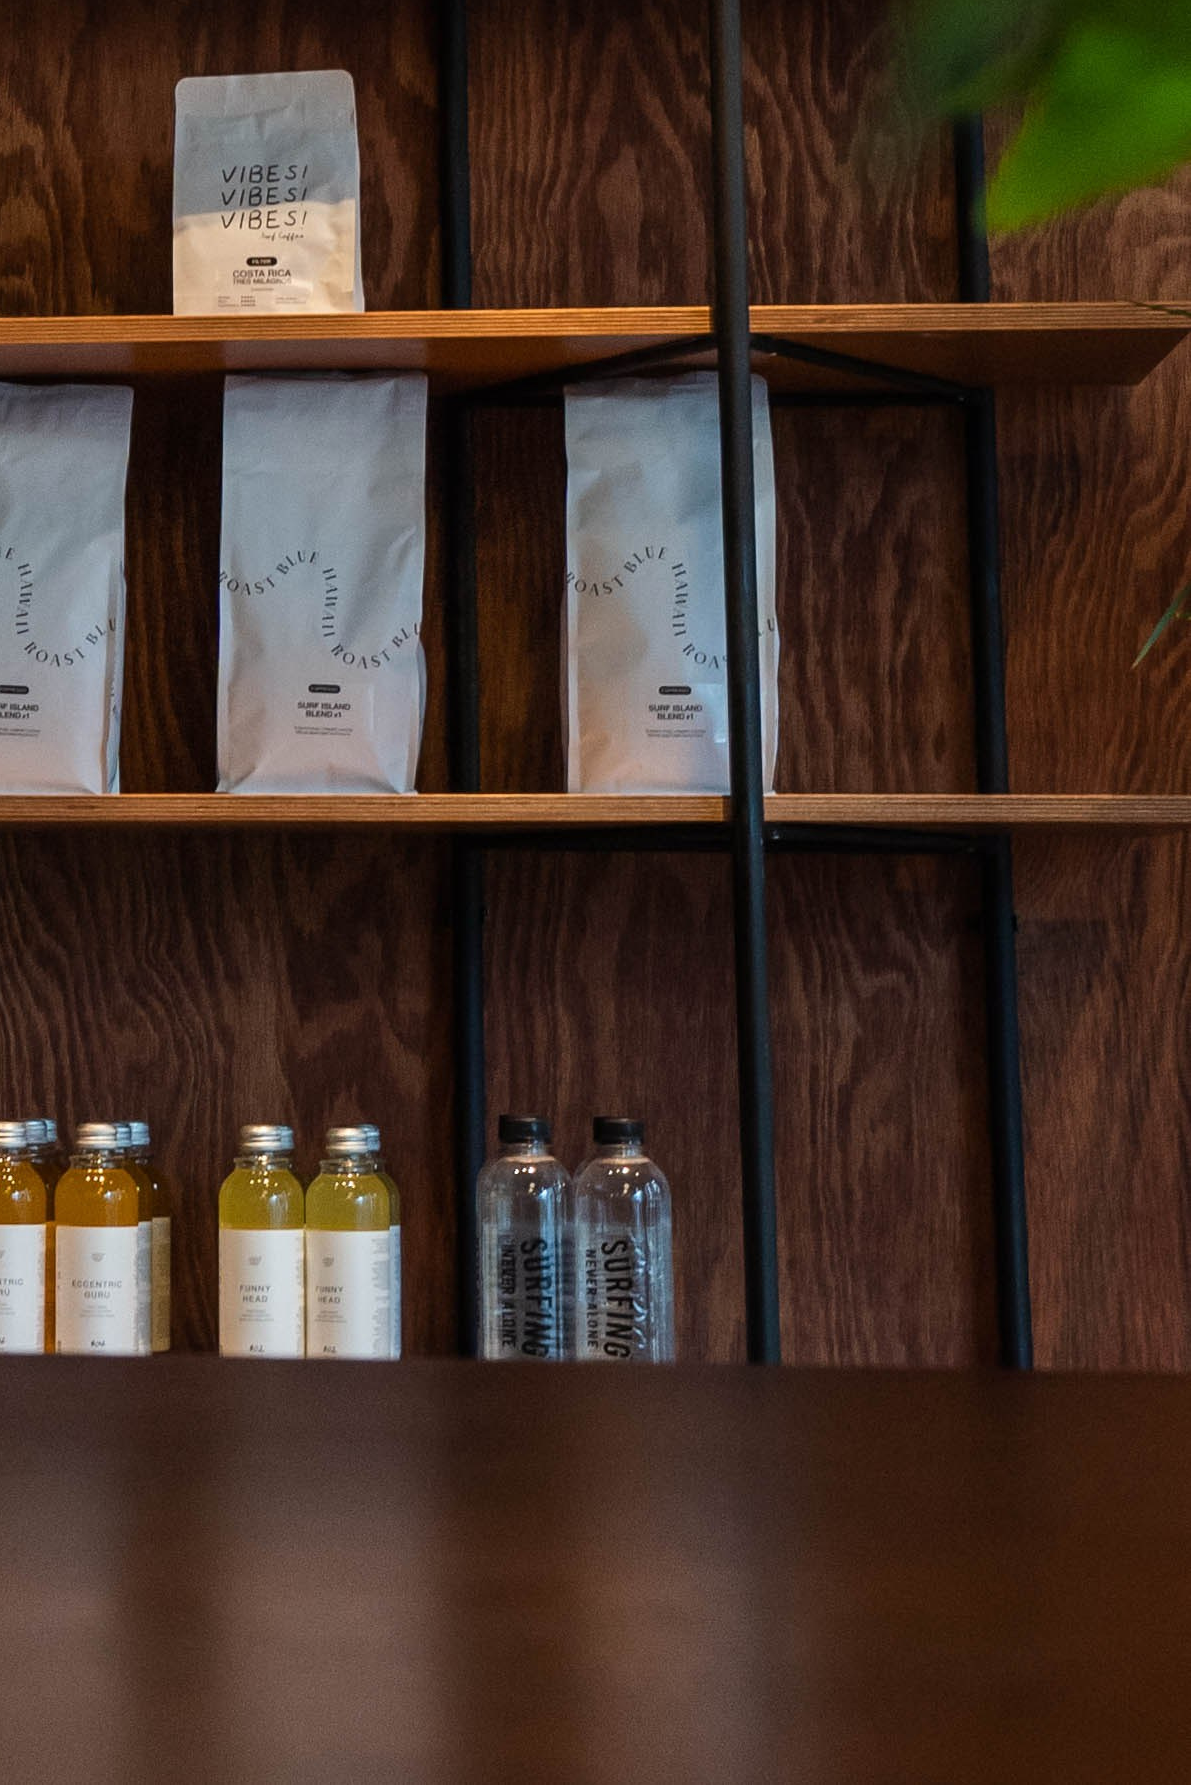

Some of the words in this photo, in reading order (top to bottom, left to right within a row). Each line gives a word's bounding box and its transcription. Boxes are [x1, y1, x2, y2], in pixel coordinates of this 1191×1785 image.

[222, 164, 308, 184] VIBES!
[221, 186, 308, 207] VIBES!
[221, 209, 307, 230] VIBES!
[232, 269, 265, 278] COSTA
[267, 269, 292, 277] RICA
[624, 546, 667, 573] BLUE
[276, 550, 319, 575] BLUE
[330, 644, 391, 669] ROAST
[24, 641, 85, 668] ROAST
[501, 1244, 517, 1295] NEVER
[585, 1249, 599, 1296] NEVER
[71, 1279, 123, 1288] ECCENTRIC
[239, 1285, 271, 1293] FUNNY
[315, 1285, 344, 1294] FUNNY
[84, 1290, 111, 1299] GURU
[242, 1295, 269, 1303] HEAD
[318, 1296, 341, 1304] HEAD
[520, 1238, 553, 1358] SURFING
[601, 1240, 634, 1359] SURFING
[586, 1302, 599, 1349] ALONE
